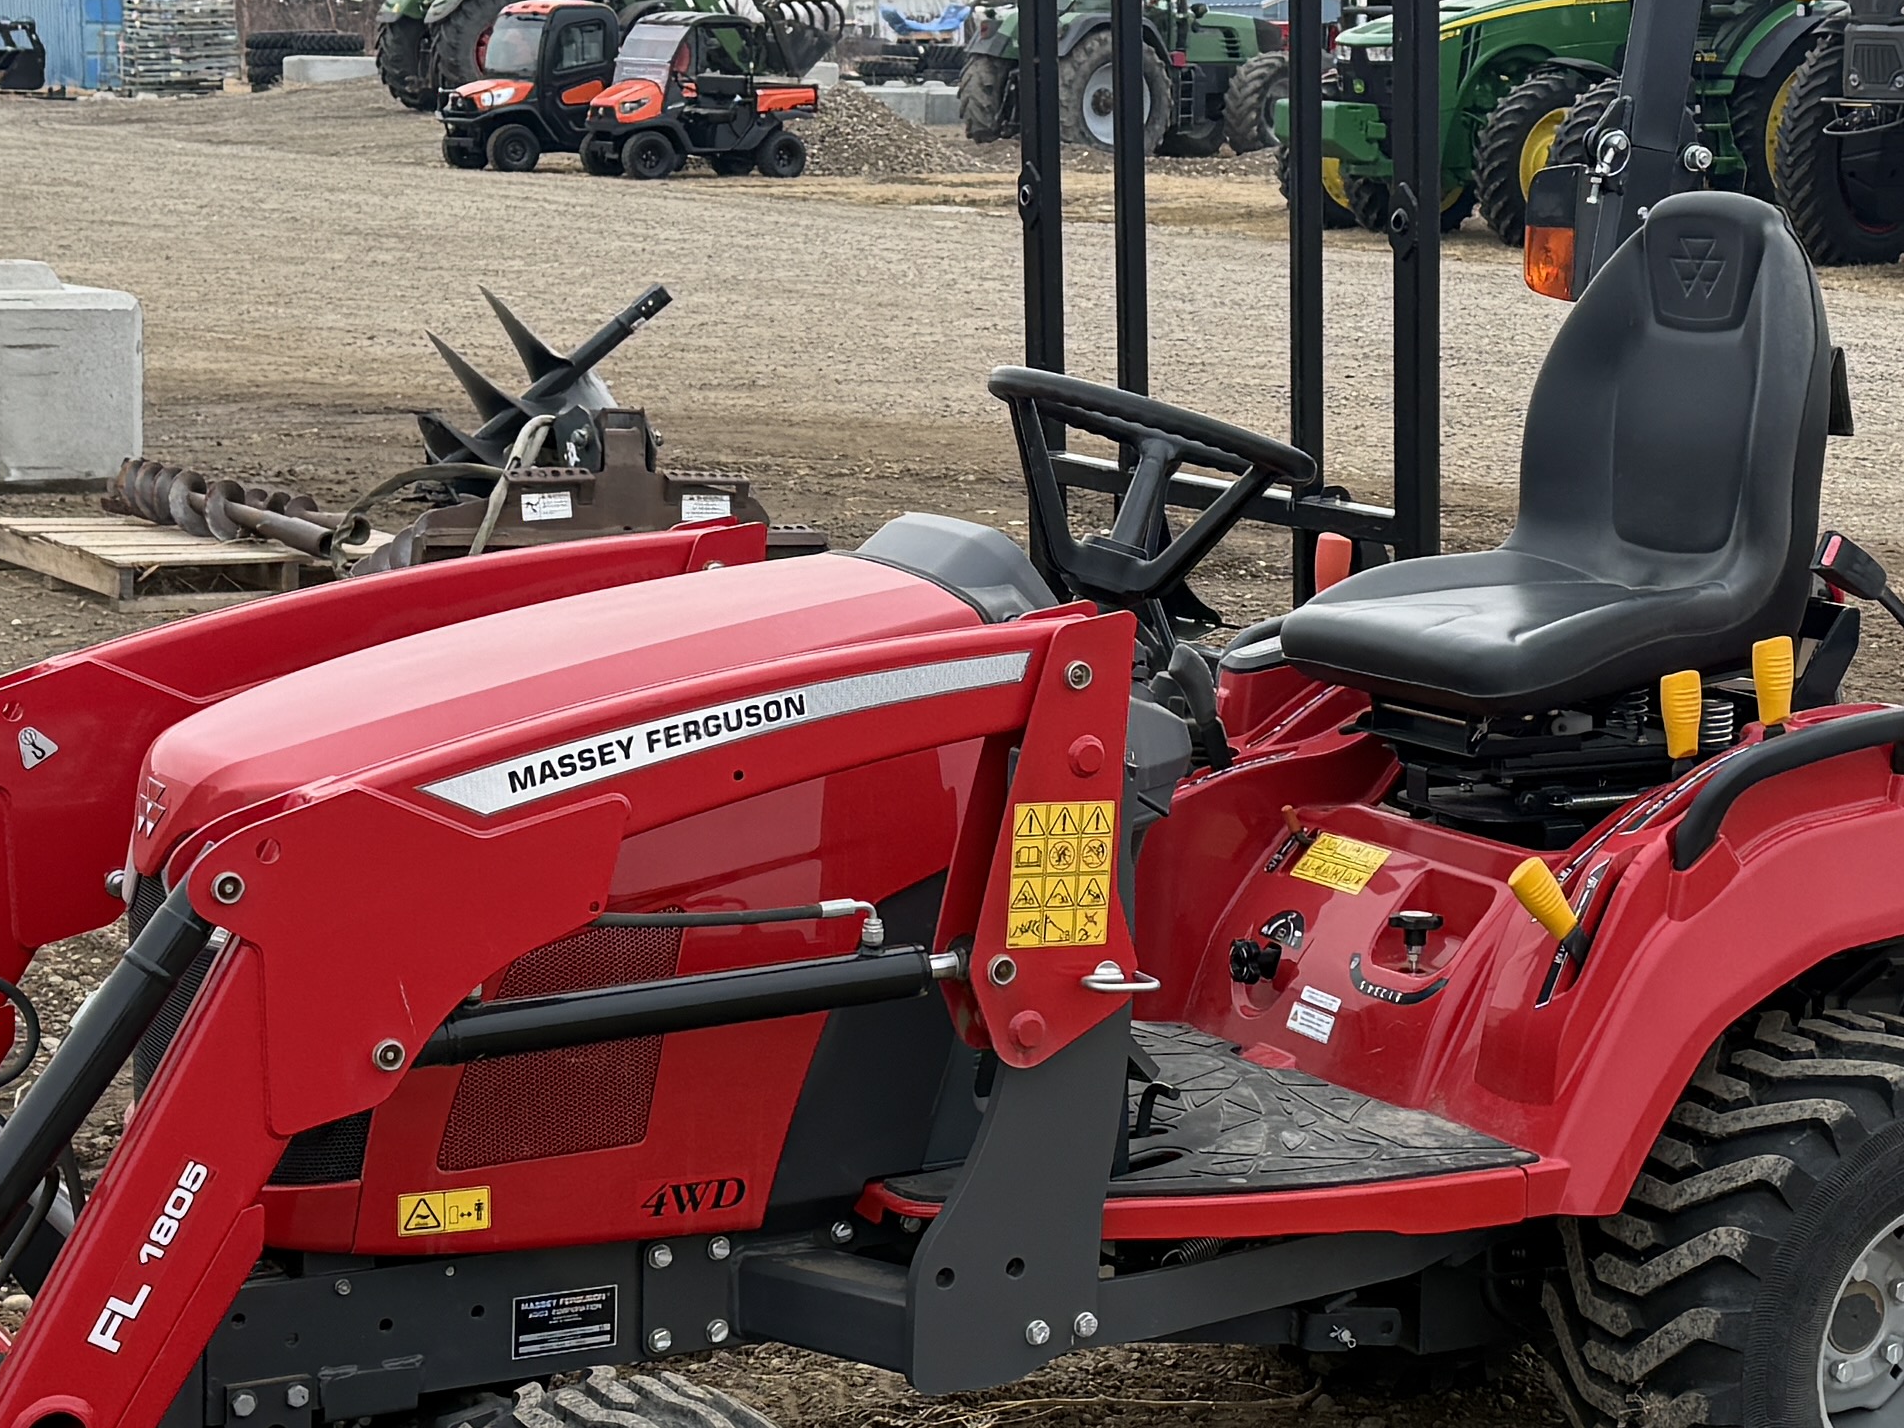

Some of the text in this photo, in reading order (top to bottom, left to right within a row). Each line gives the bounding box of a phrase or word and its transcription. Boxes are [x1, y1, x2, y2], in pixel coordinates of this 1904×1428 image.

[508, 693, 806, 793] MASSEY FERGUSON
[640, 1177, 747, 1217] 4WD
[86, 1160, 208, 1354] FL 1805
[521, 1293, 606, 1310] MASSEY FERGUSON
